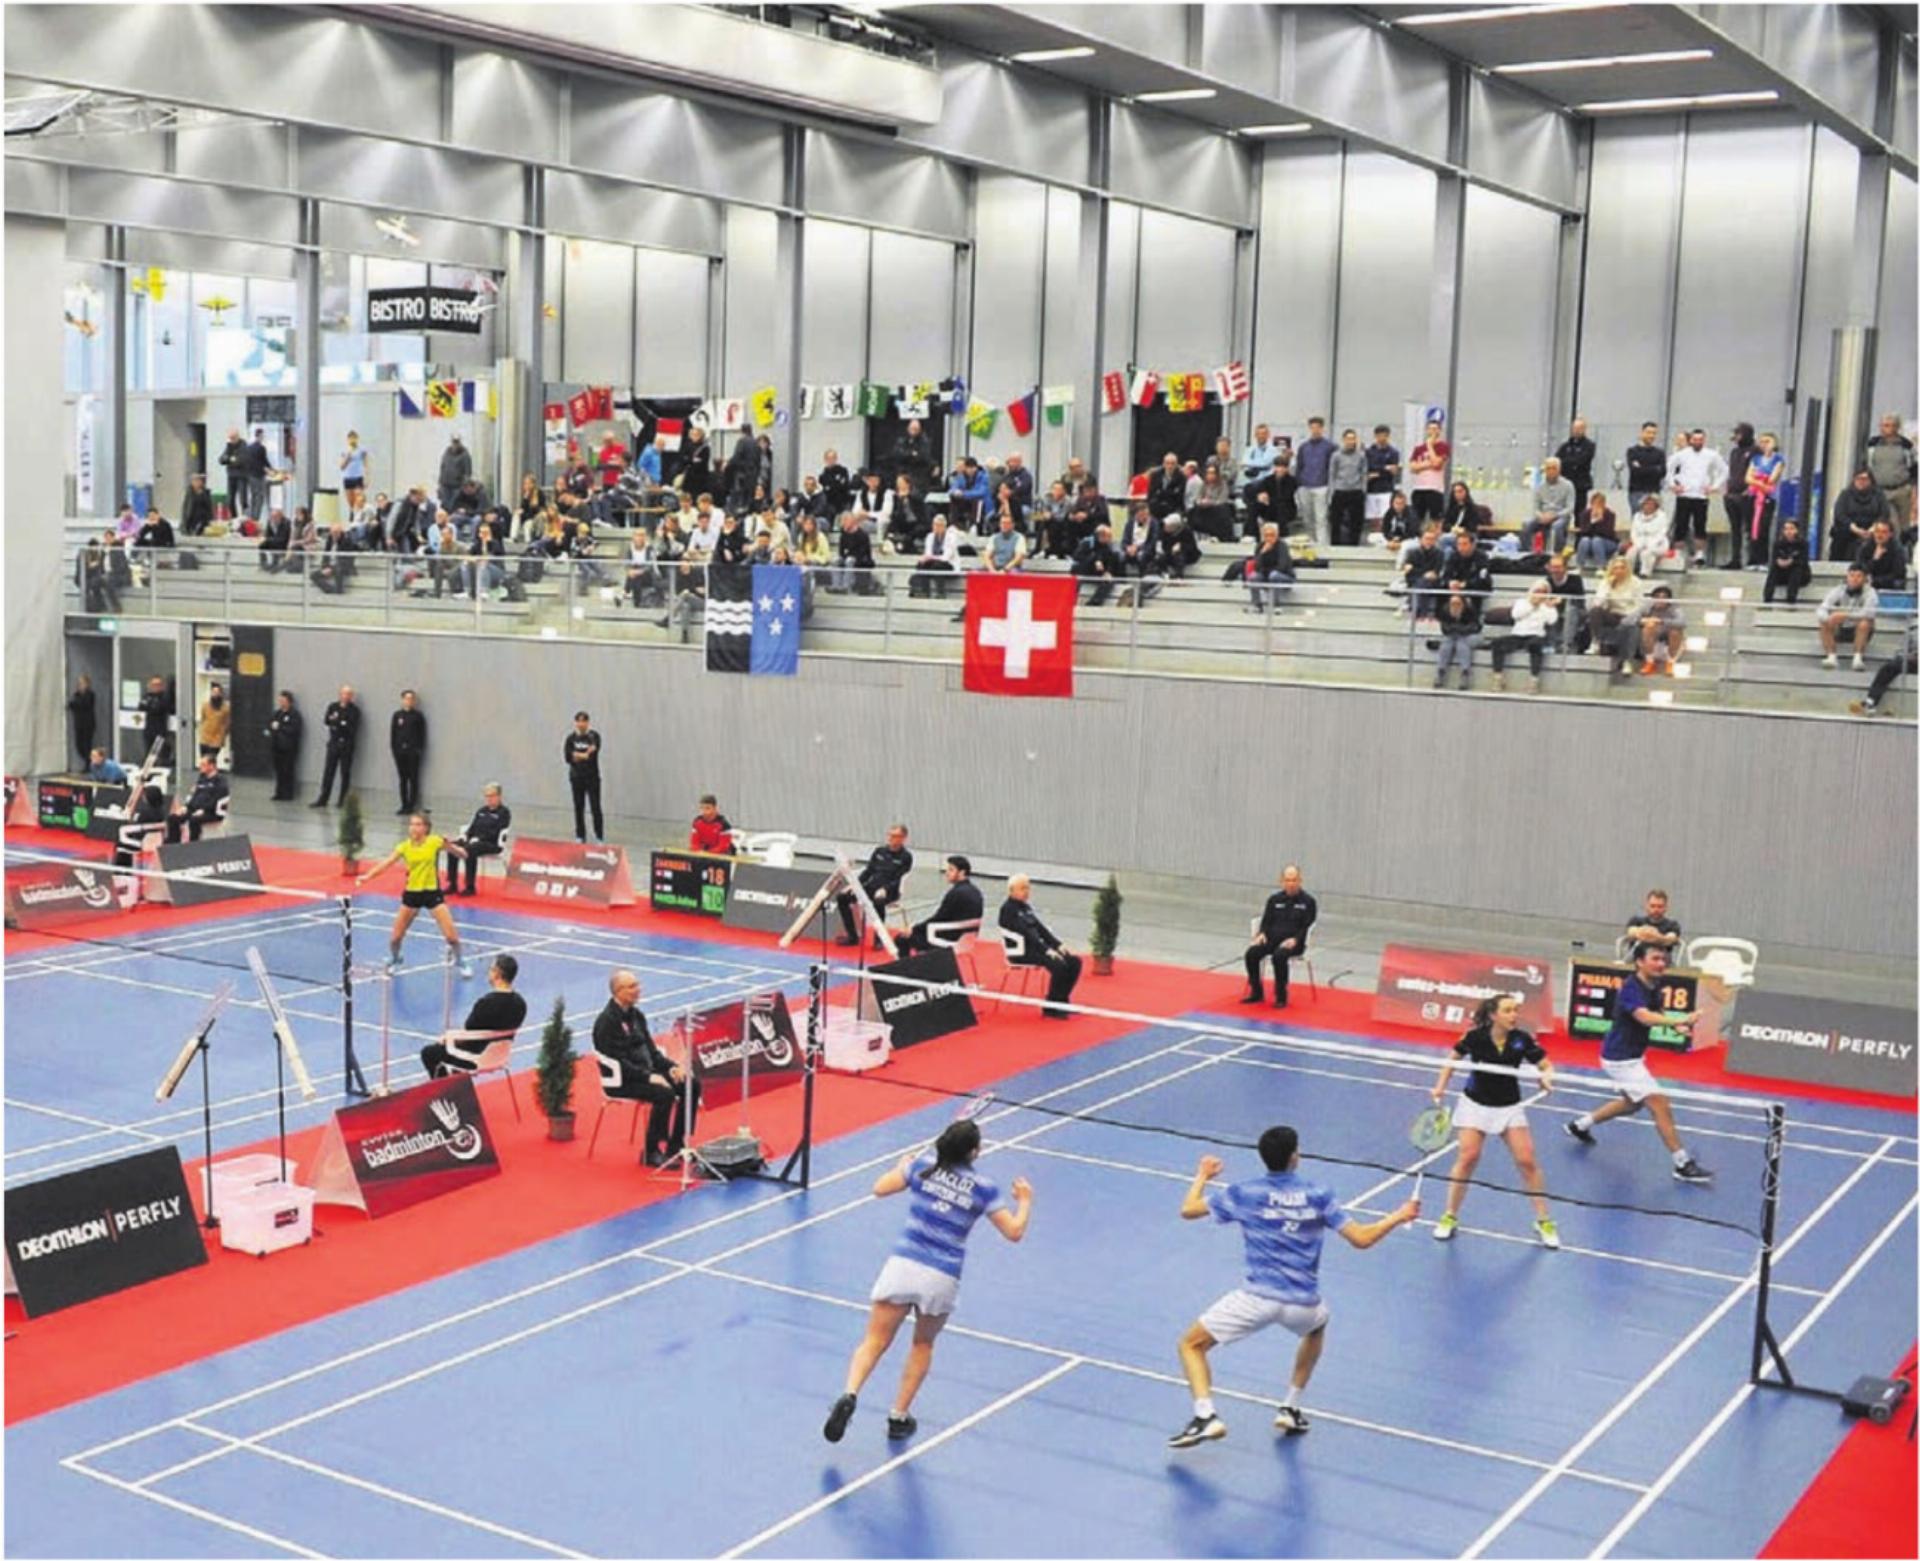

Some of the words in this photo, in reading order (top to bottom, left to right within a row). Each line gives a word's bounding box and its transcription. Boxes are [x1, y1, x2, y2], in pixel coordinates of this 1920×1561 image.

[370, 297, 425, 322] BISTRO
[1661, 985, 1688, 1009] 18
[1740, 1023, 1830, 1048] DECATHLON
[1838, 1035, 1913, 1060] PERFLY
[362, 1128, 446, 1169] badminton
[16, 1217, 109, 1261] DECATHLON
[114, 1195, 181, 1232] PERFLY
